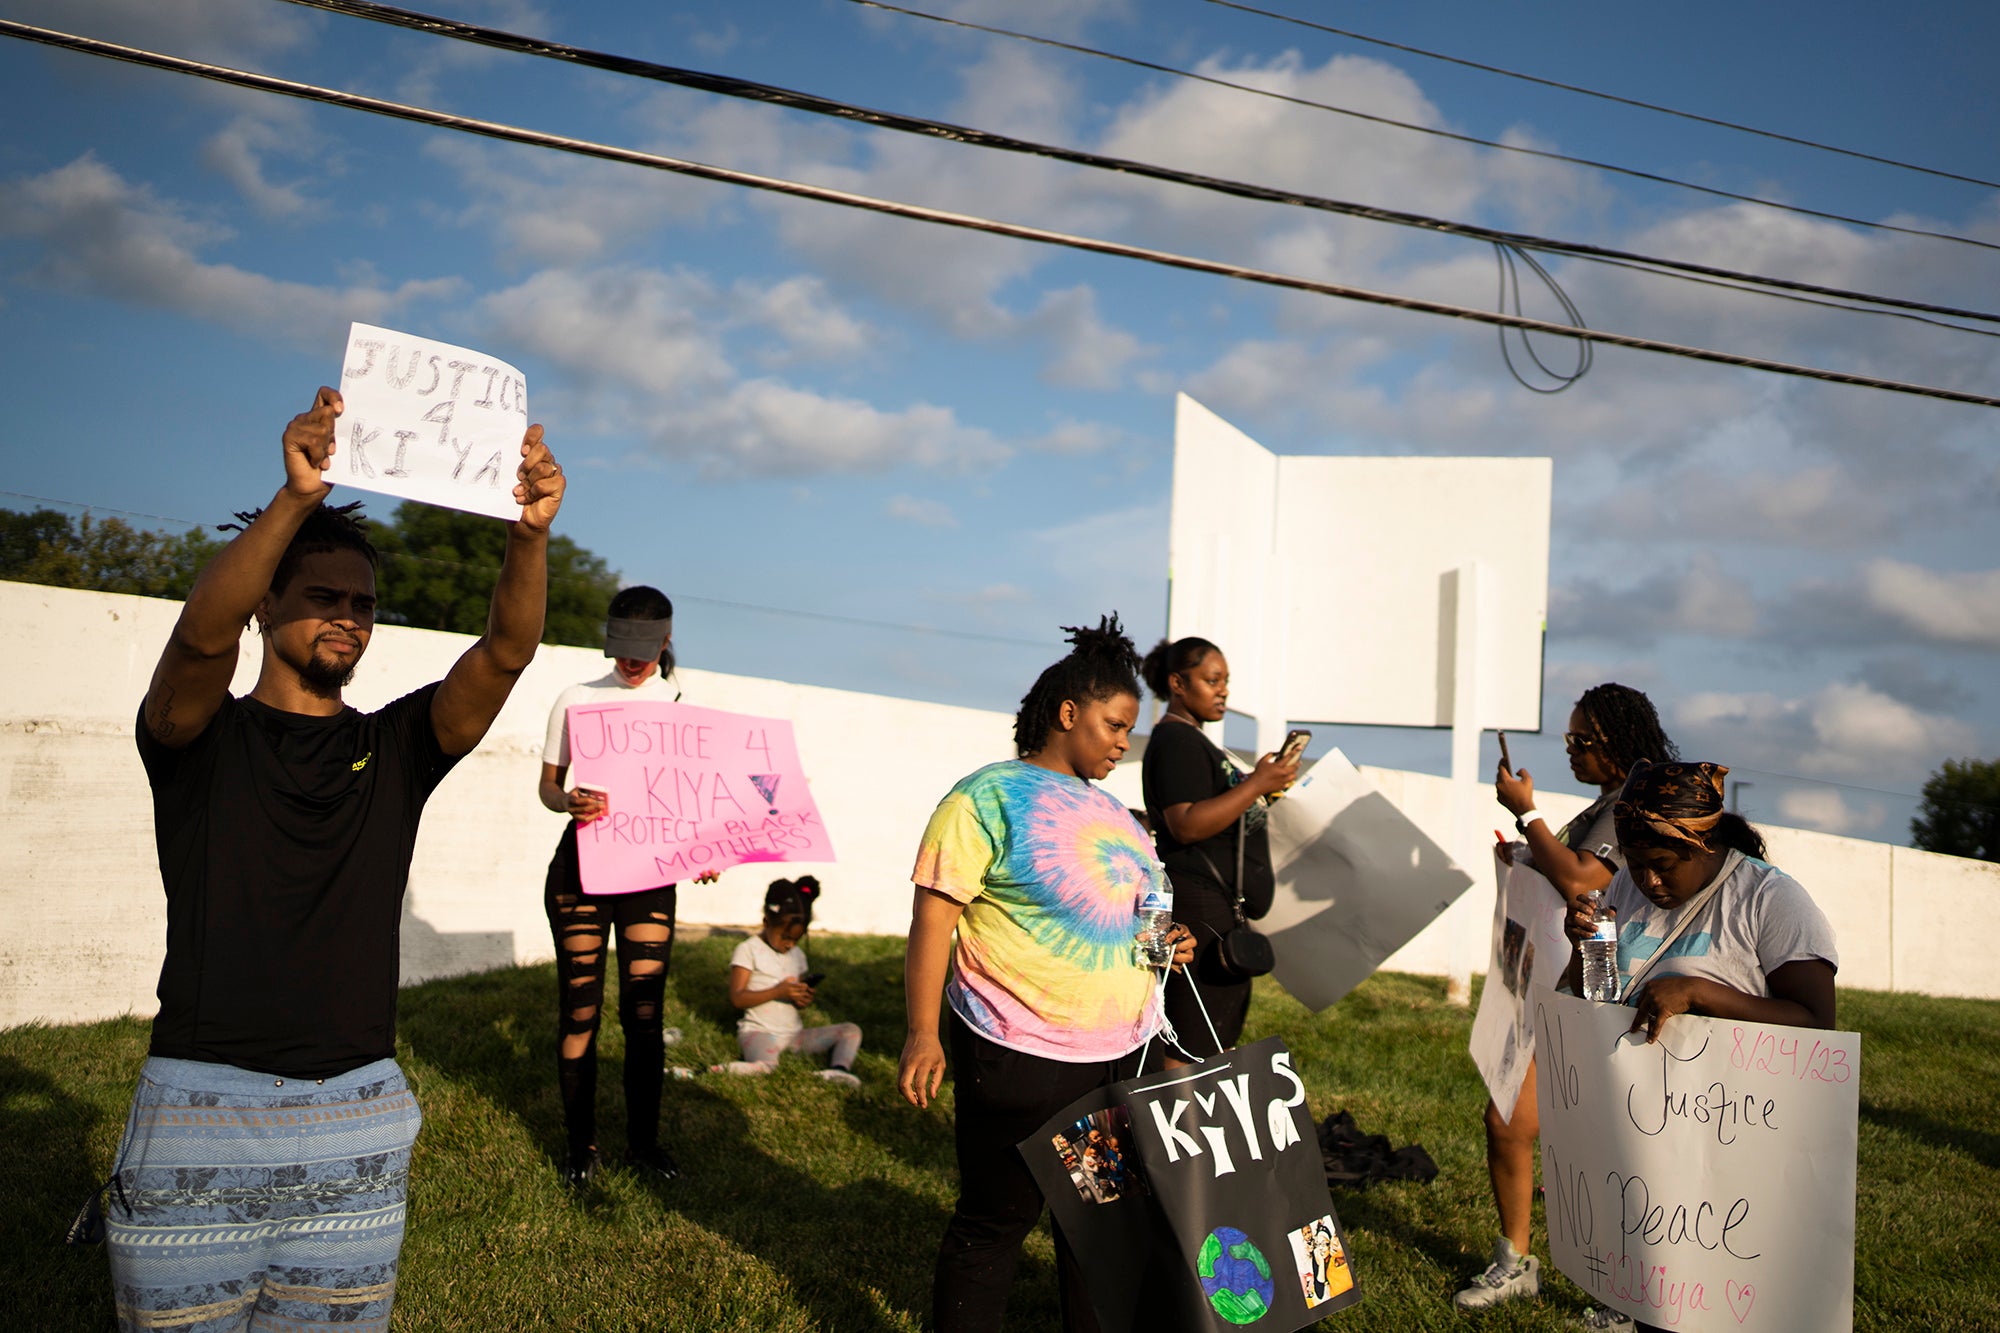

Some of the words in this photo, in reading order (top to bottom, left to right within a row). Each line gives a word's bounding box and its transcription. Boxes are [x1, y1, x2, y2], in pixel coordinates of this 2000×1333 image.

[345, 339, 526, 416] JUSTICE
[421, 400, 456, 446] 4
[575, 708, 713, 760] JUSTICE
[745, 728, 773, 771] 4
[593, 811, 700, 846] PROTECT
[724, 812, 820, 836] BLACK
[654, 828, 812, 877] MOTHERS
[1538, 1003, 1579, 1110] No
[1614, 1029, 1779, 1145] Justice
[1730, 1027, 1850, 1083] 8/24/23
[1606, 1171, 1761, 1268] Peace
